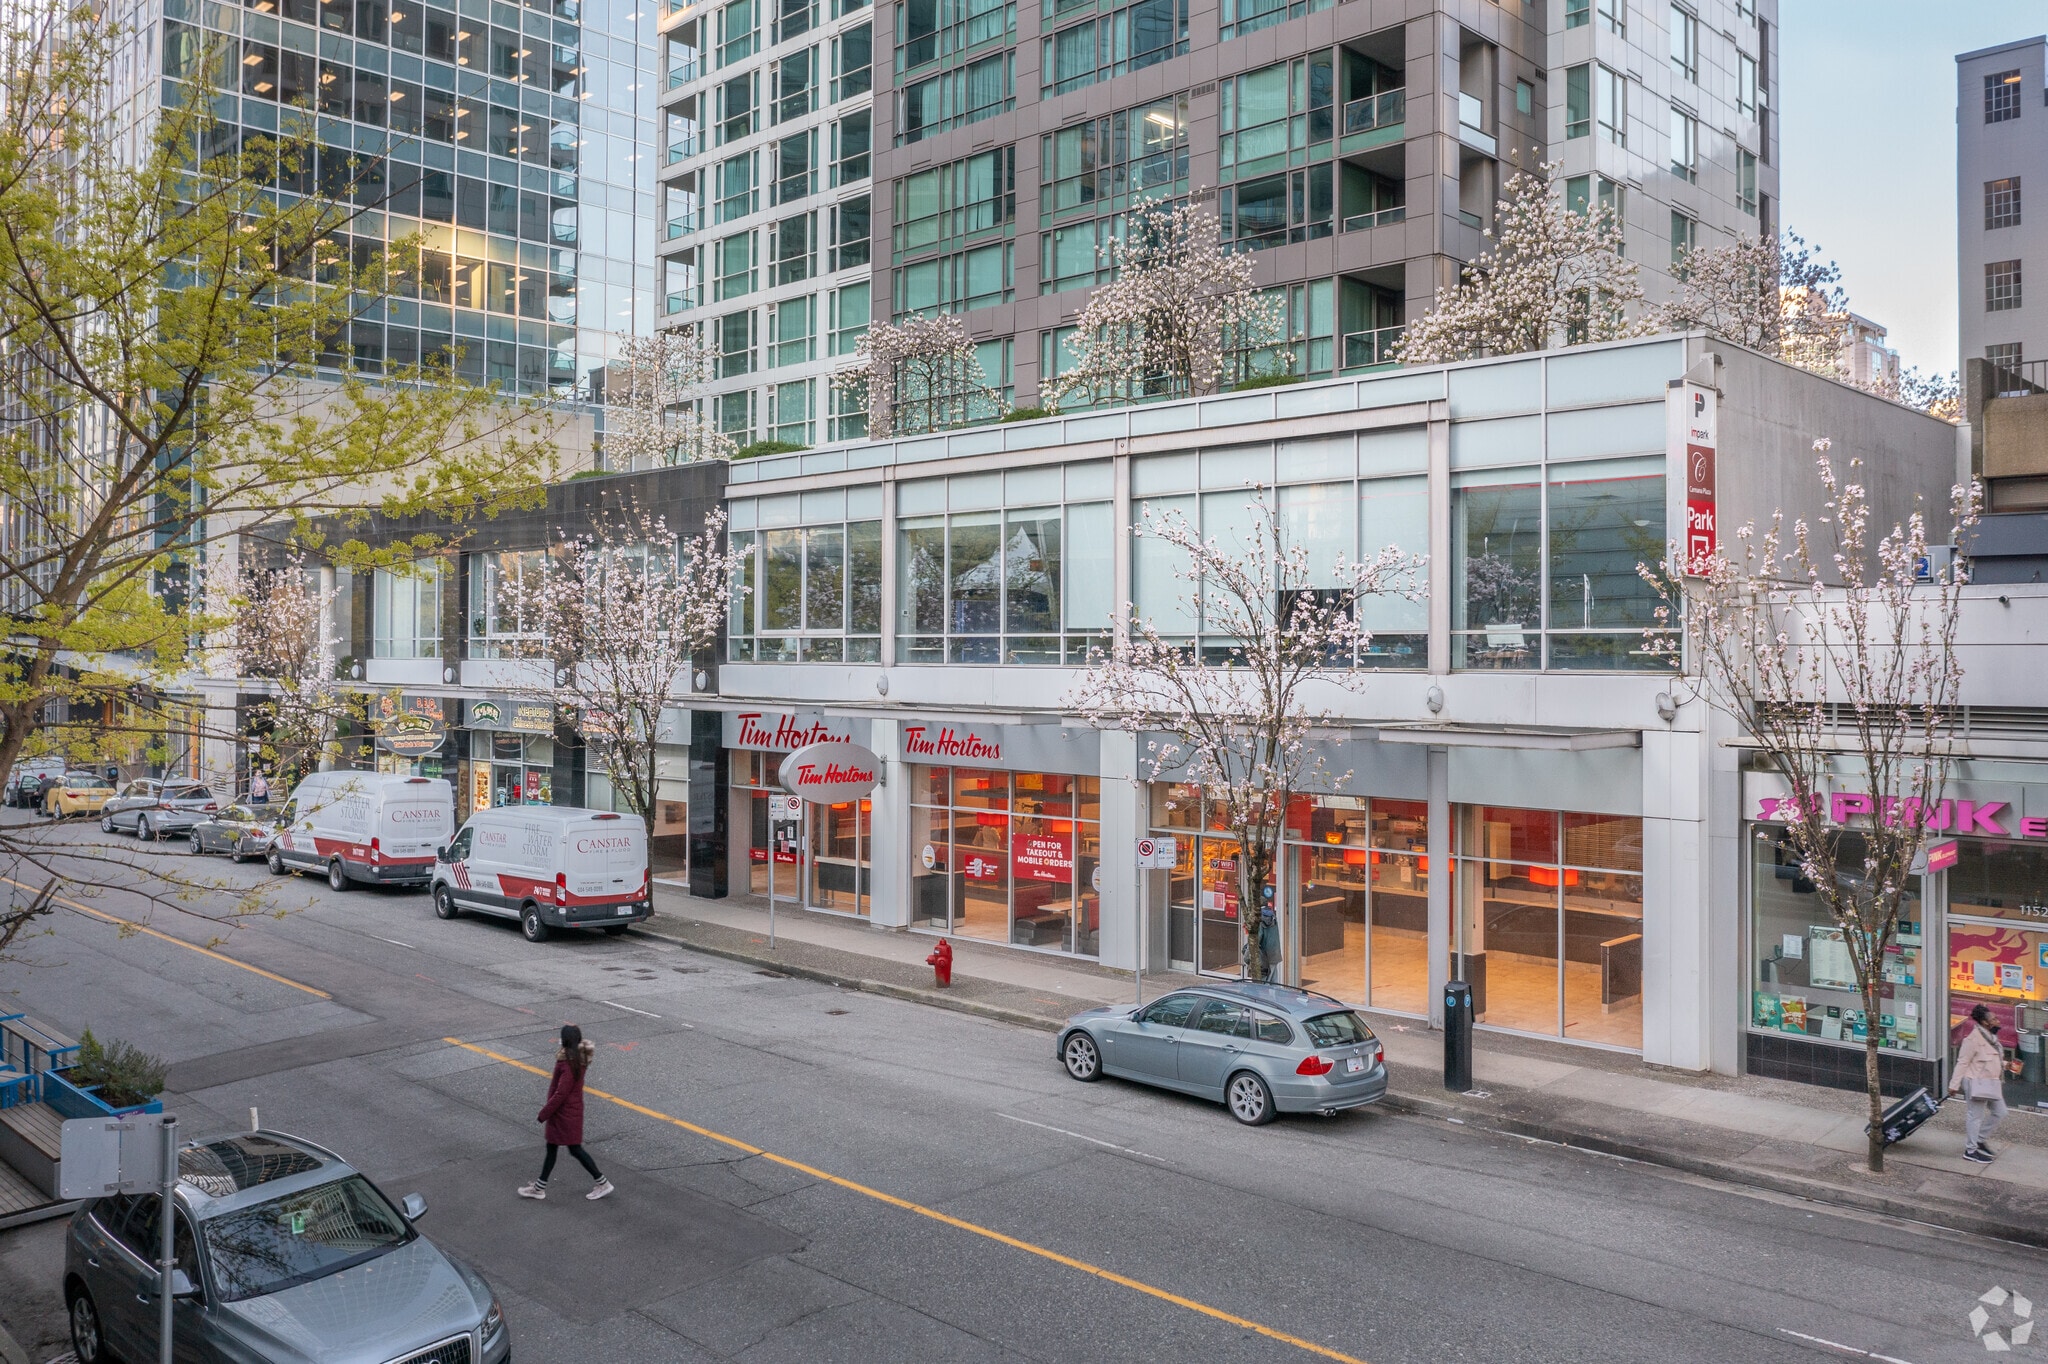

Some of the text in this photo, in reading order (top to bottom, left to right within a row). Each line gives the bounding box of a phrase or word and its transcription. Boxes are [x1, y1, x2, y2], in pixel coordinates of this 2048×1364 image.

[1690, 426, 1710, 440] impark
[1687, 506, 1714, 531] Park
[517, 703, 550, 720] Neptune
[738, 712, 772, 748] Tim
[905, 726, 1000, 759] Tim Hortons
[797, 763, 873, 786] Tim Hortons
[340, 806, 366, 821] STORM
[392, 809, 441, 823] CANSTAR
[525, 823, 540, 834] FIRE
[480, 831, 507, 845] CANSTAR
[528, 833, 552, 847] WATER
[522, 843, 548, 857] STORM
[576, 837, 631, 854] CANSTAR
[1047, 842, 1061, 850] FOR
[1026, 848, 1057, 858] TAKEOUT
[1017, 856, 1073, 868] MOBILE ORDERS
[2019, 904, 2048, 918] 1152
